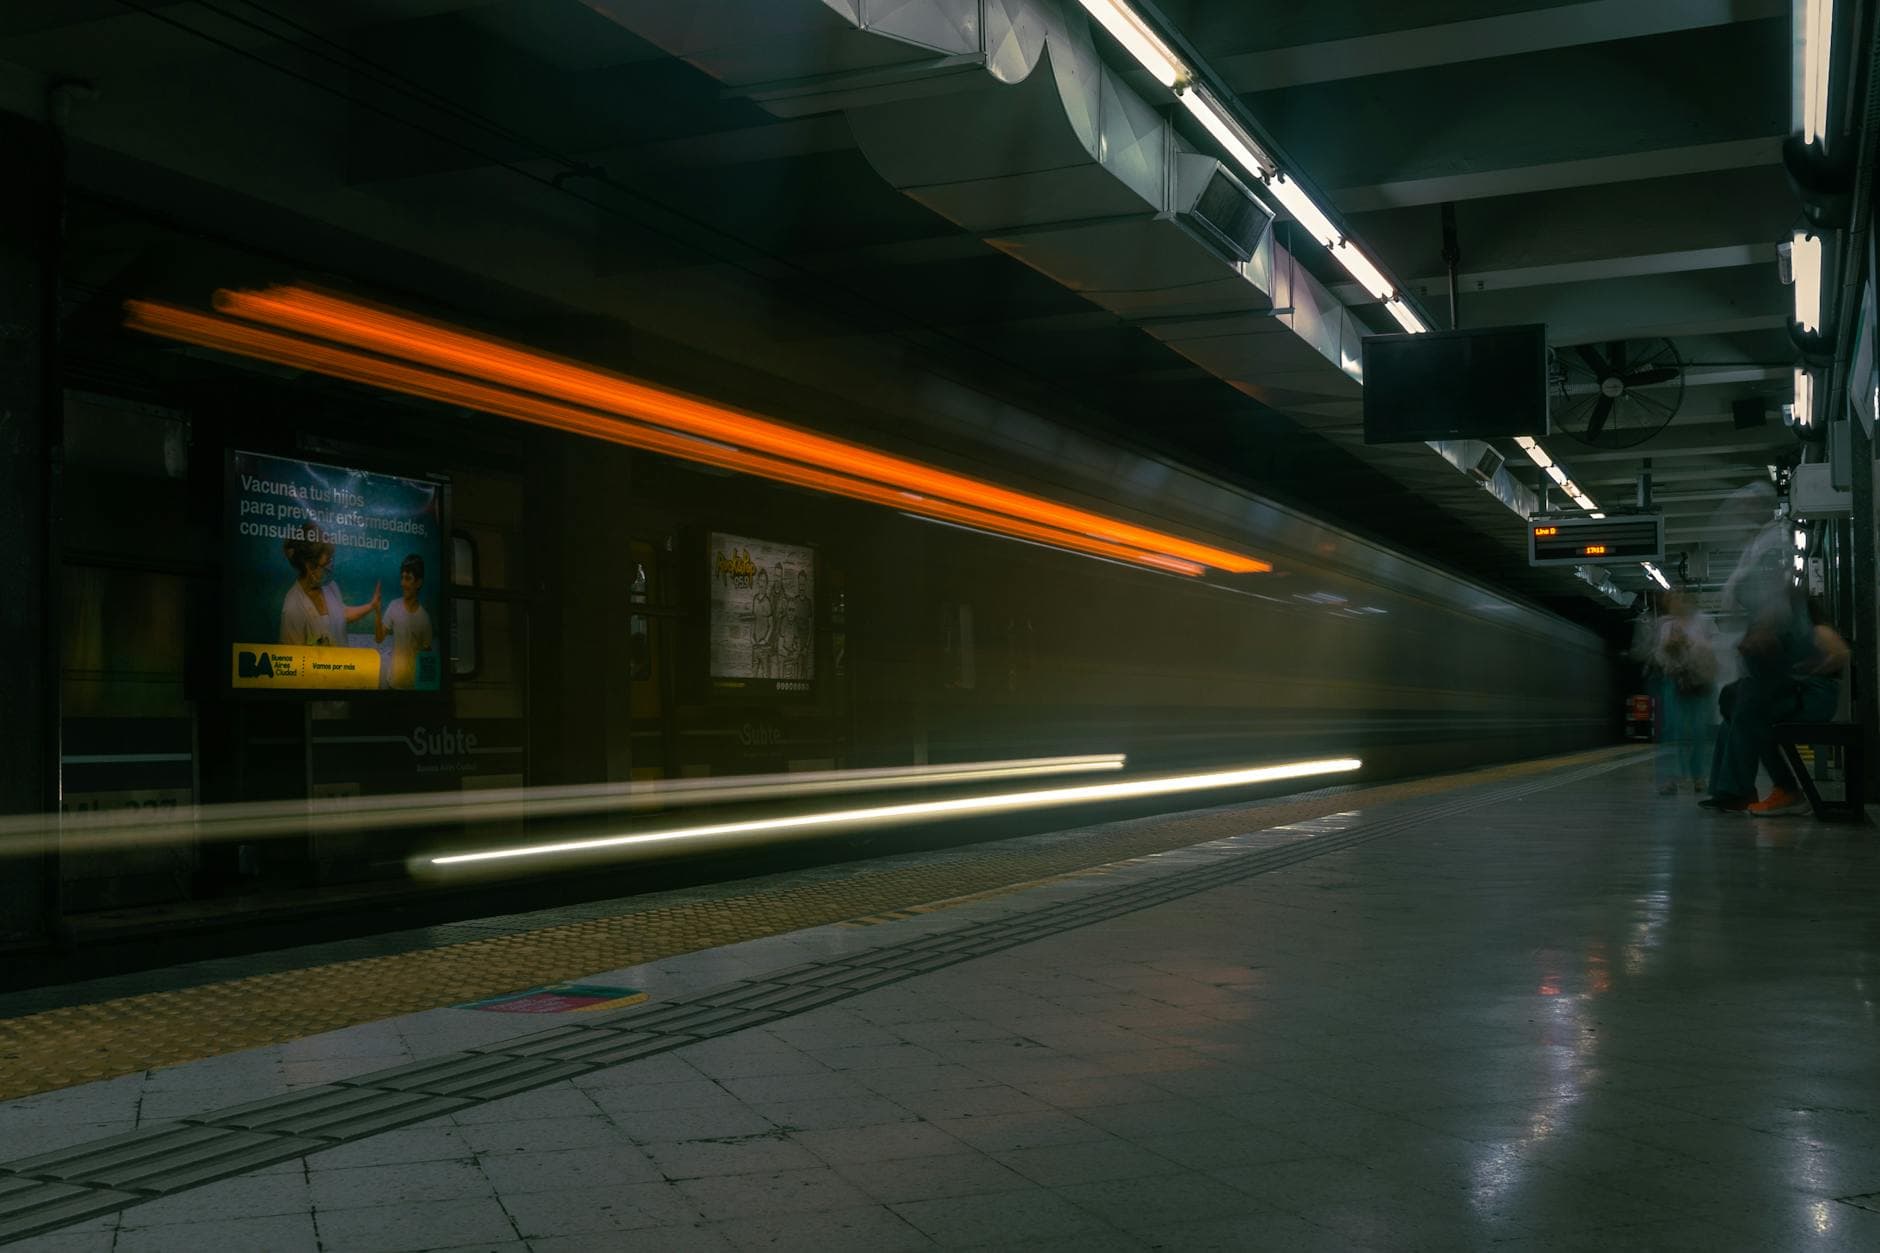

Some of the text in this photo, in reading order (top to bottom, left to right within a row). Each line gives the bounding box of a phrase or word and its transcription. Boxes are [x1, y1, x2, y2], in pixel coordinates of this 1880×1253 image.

[240, 474, 364, 508] Vacuná a tus hijos
[240, 499, 276, 518] para
[277, 505, 337, 522] prevenir
[240, 521, 390, 551] consultá el calendario
[238, 651, 274, 678] BA
[271, 654, 293, 662] Buenos
[312, 662, 332, 670] Vamos
[332, 663, 343, 672] por
[276, 669, 297, 677] Ciudad
[413, 726, 478, 756] Subte
